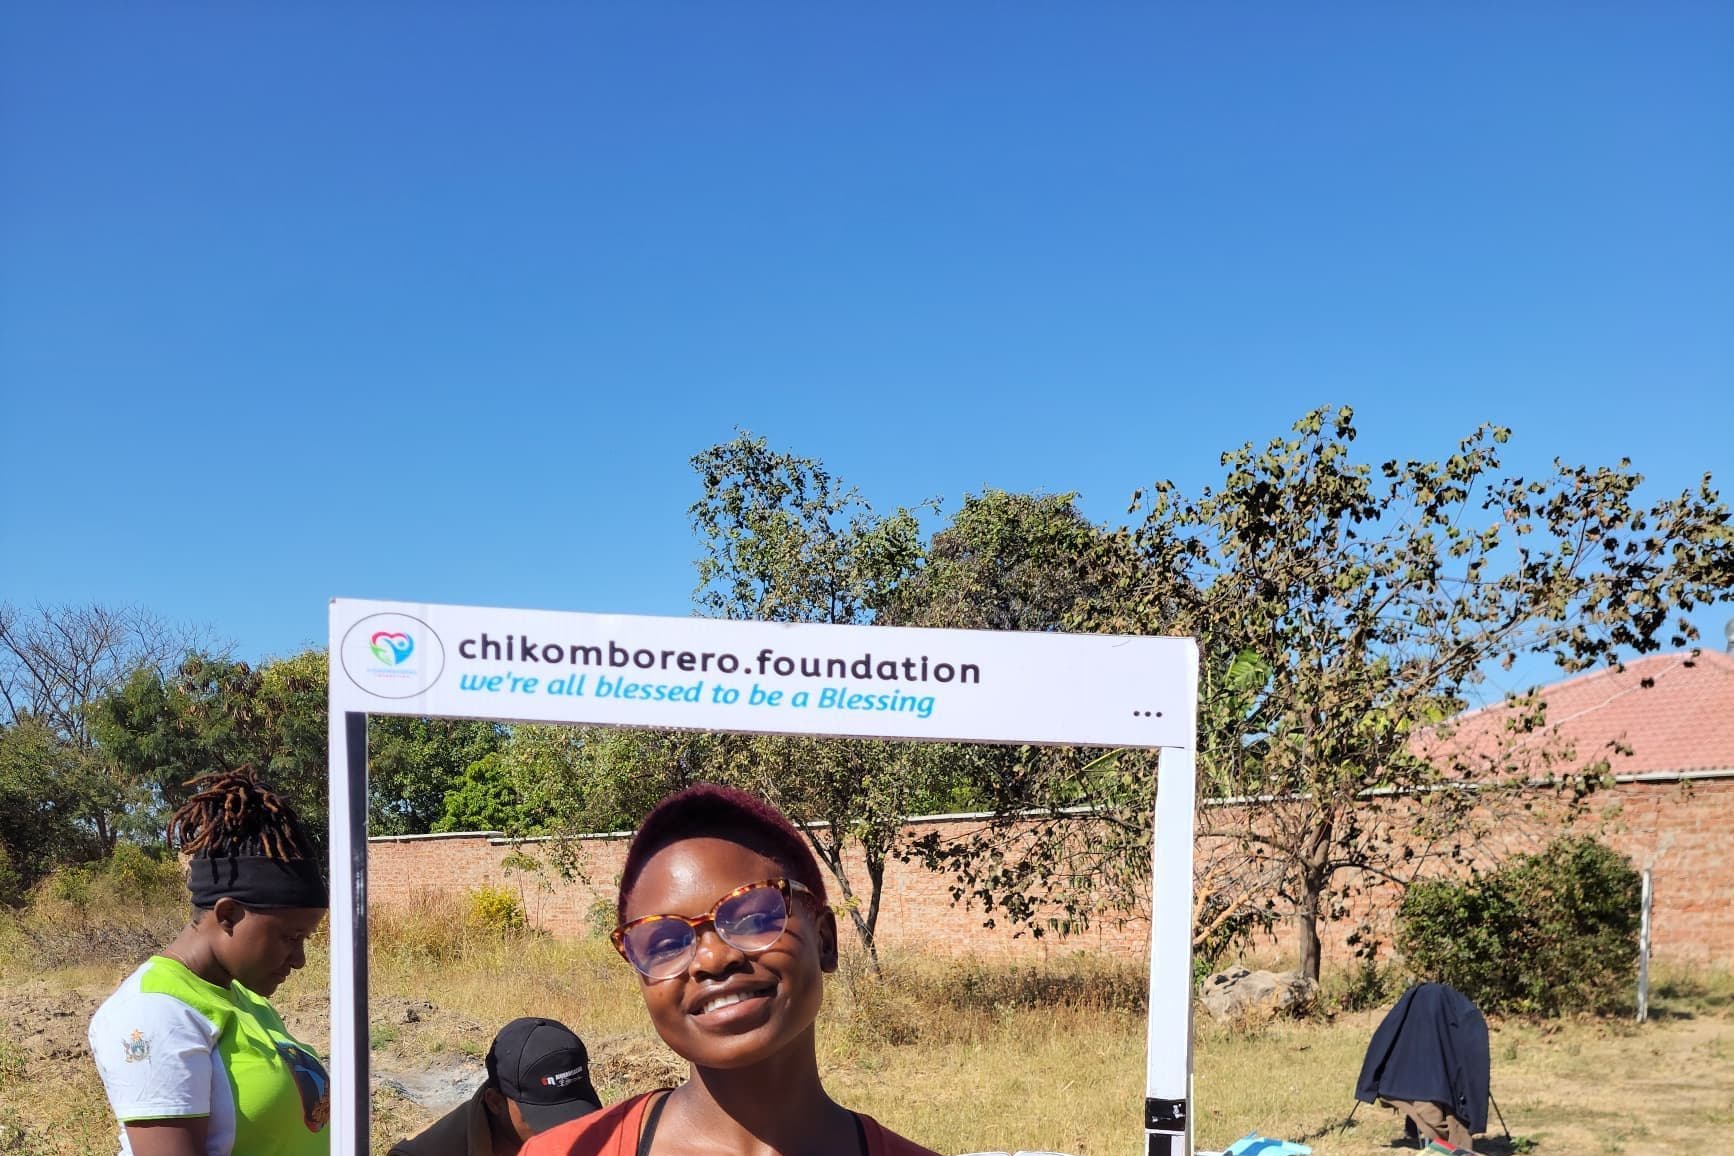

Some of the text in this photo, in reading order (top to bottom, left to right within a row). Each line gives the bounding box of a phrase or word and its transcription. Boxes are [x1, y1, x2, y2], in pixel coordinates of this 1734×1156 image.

[459, 633, 980, 685] chikomborero.foundation
[459, 672, 935, 719] we're all blessed to be a Blessing
